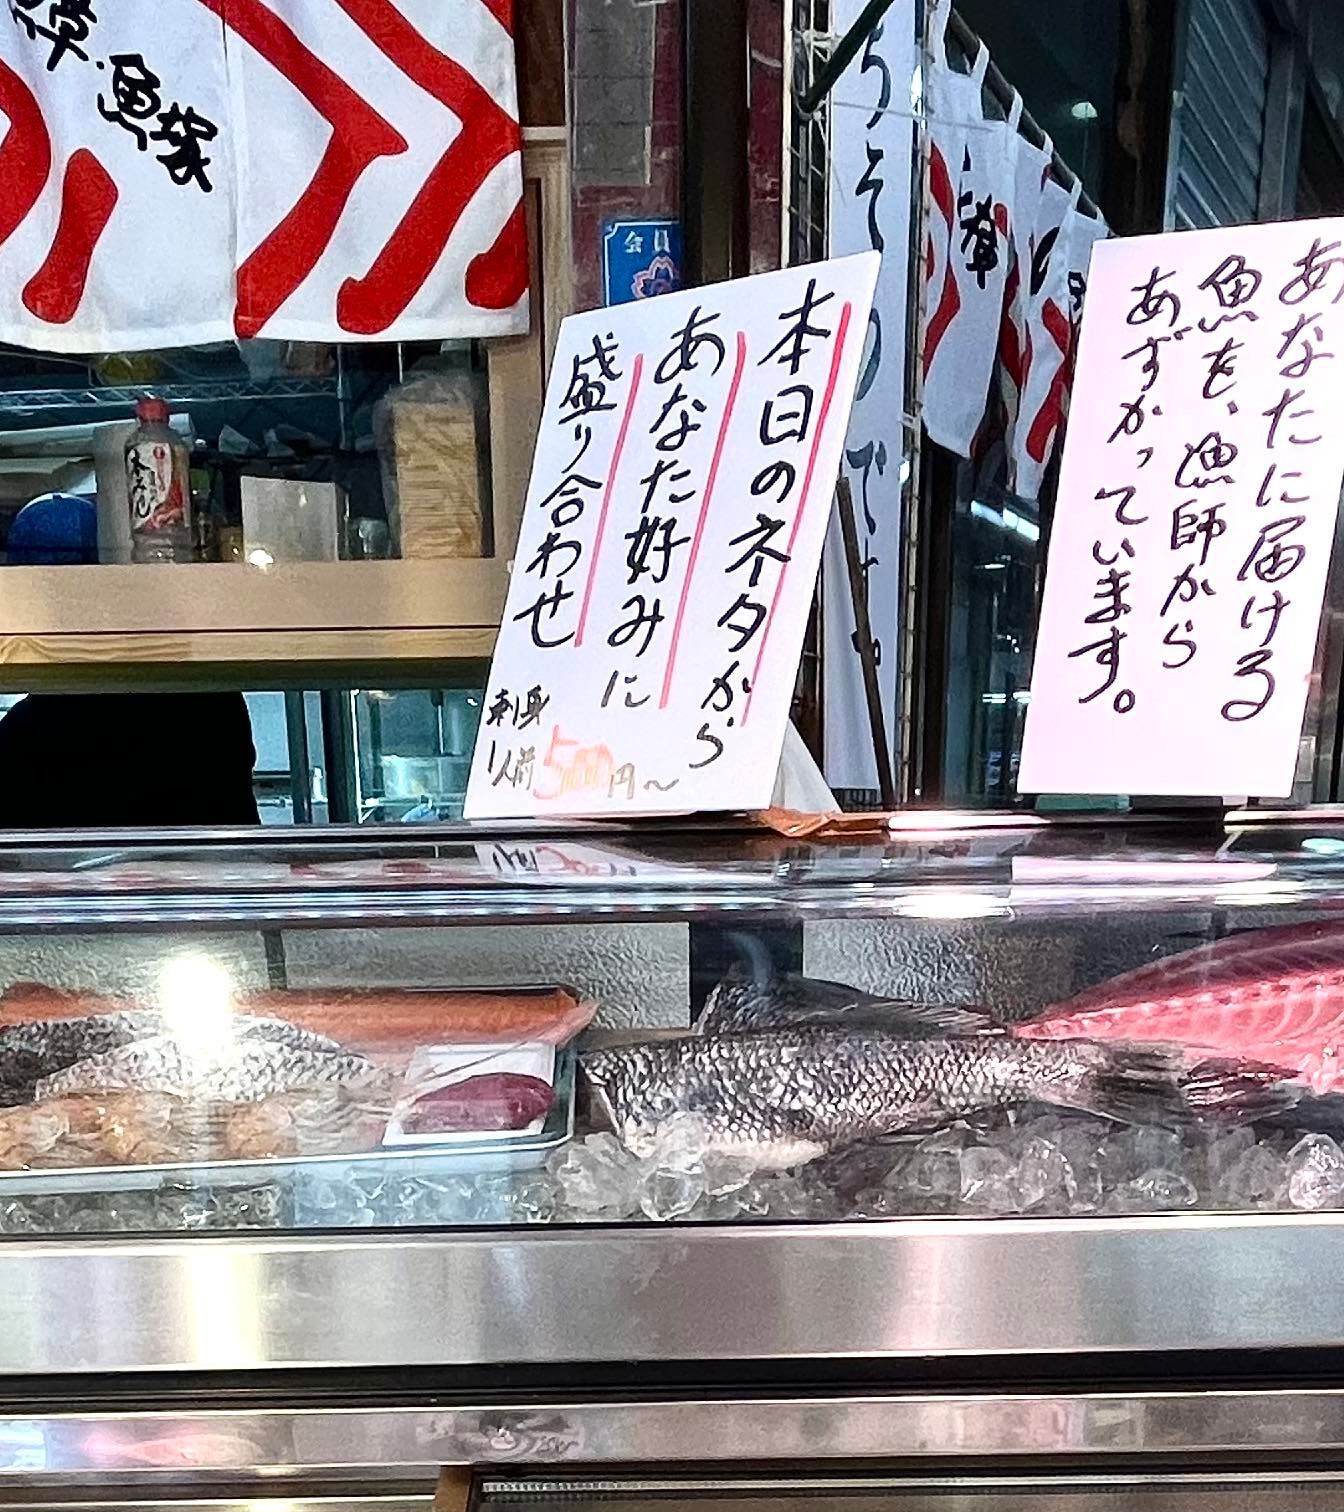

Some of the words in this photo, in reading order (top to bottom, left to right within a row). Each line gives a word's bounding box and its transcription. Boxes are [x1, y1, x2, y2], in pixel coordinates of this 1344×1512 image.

[512, 331, 624, 649] 盛り合わせ
[599, 305, 727, 711] あなた好みに
